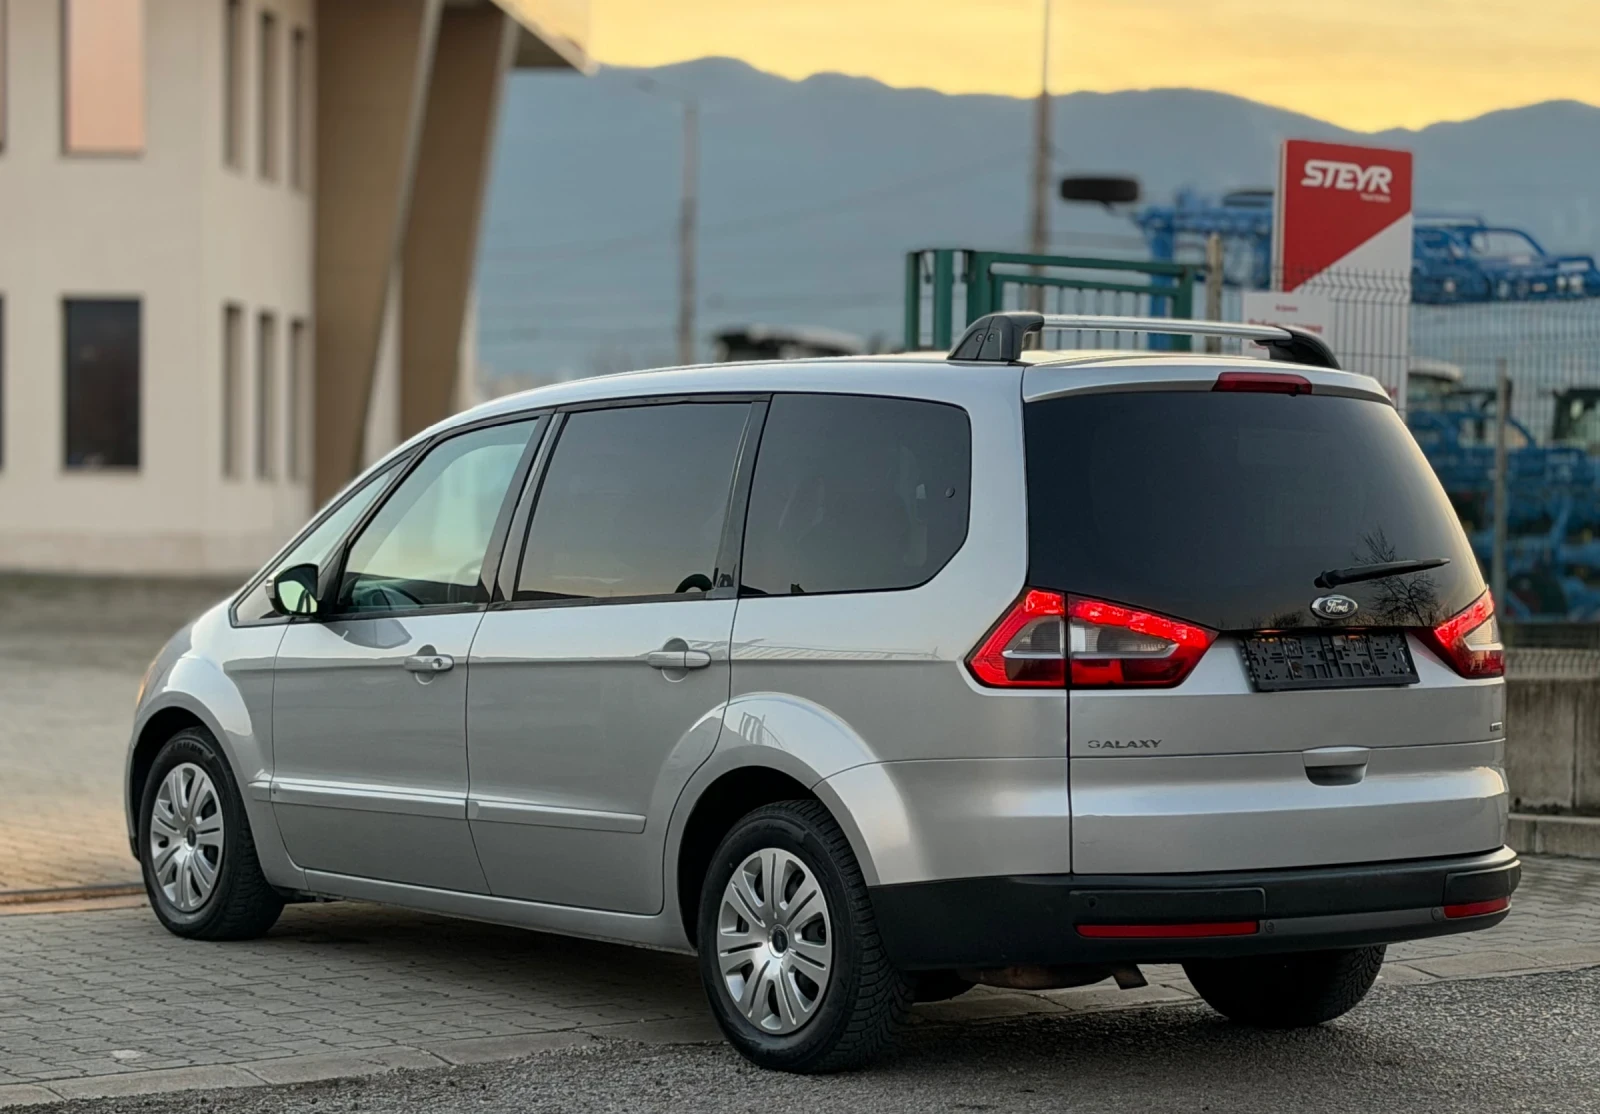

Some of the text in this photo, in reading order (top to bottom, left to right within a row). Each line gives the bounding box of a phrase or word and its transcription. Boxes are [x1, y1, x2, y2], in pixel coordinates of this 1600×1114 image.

[1300, 159, 1393, 194] STEYR
[1325, 599, 1349, 613] Ford
[1087, 739, 1162, 749] GALAXY
